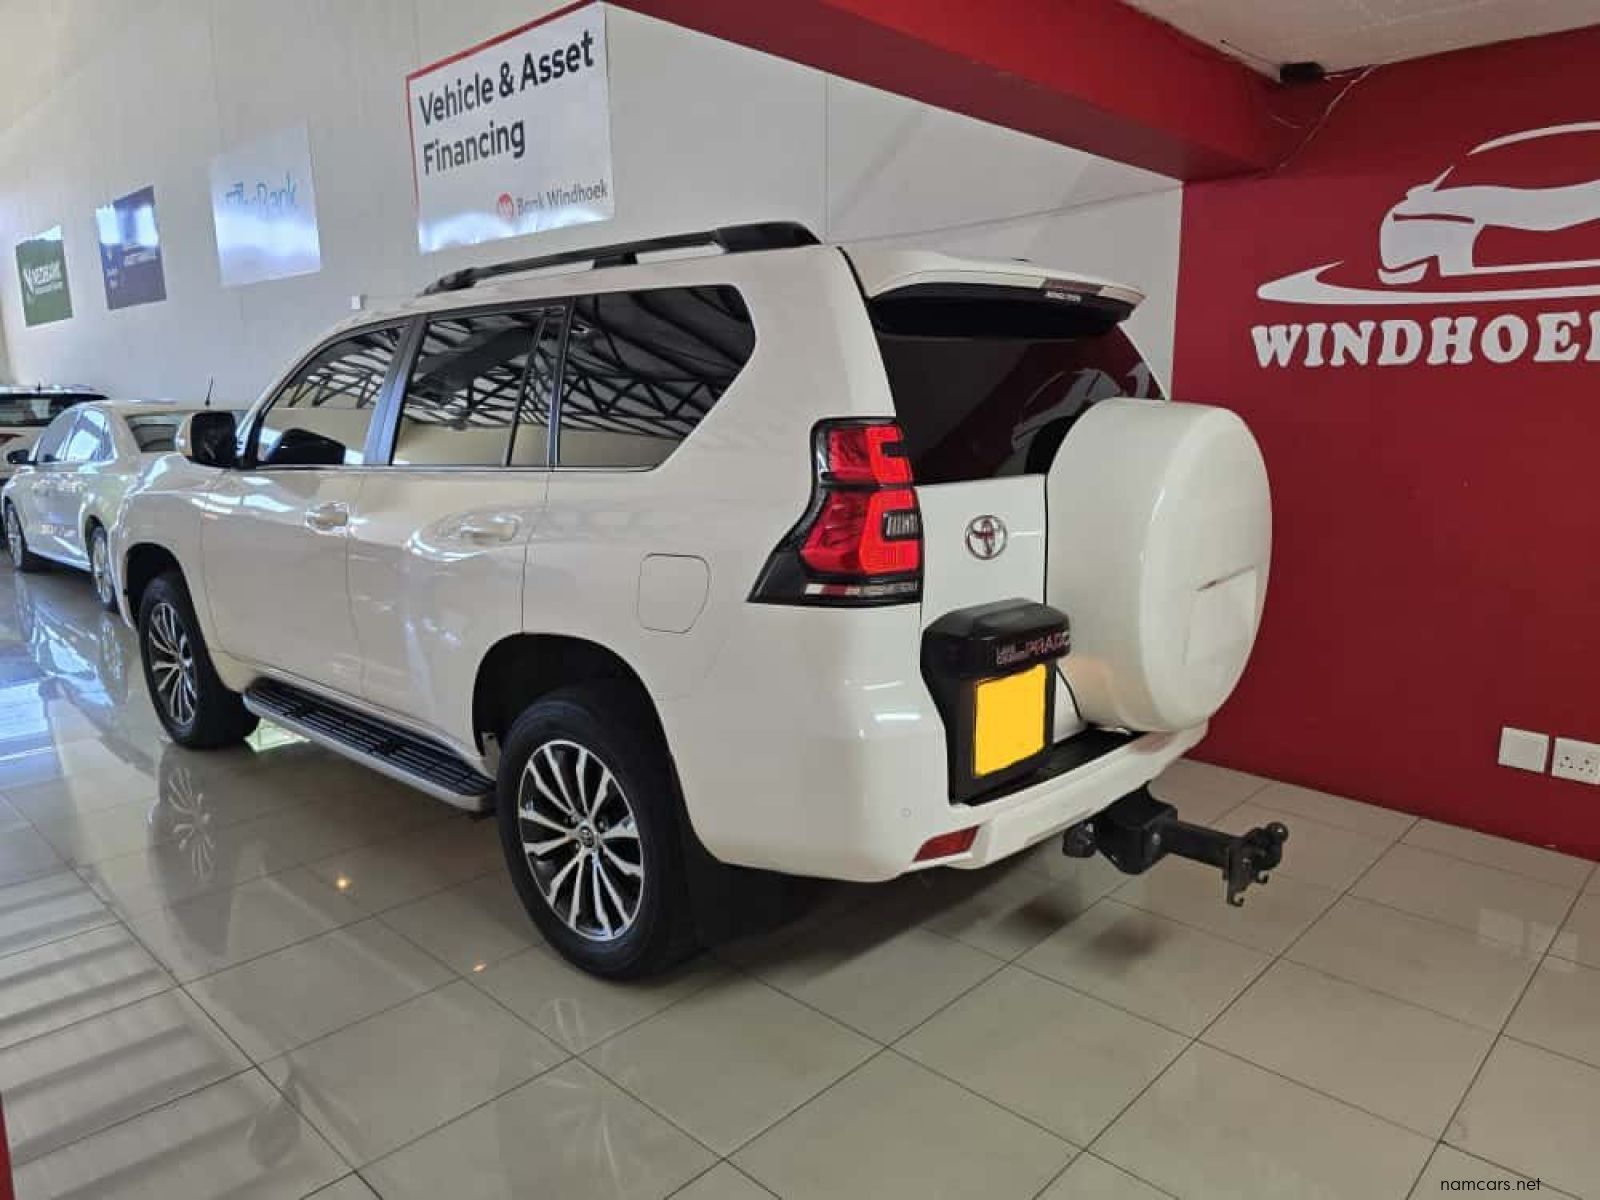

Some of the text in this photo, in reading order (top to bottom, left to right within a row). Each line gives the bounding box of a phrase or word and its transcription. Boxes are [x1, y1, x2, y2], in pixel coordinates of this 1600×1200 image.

[419, 30, 594, 126] Vehicle & Asset
[423, 120, 526, 175] Financing
[547, 178, 608, 206] Windhoek
